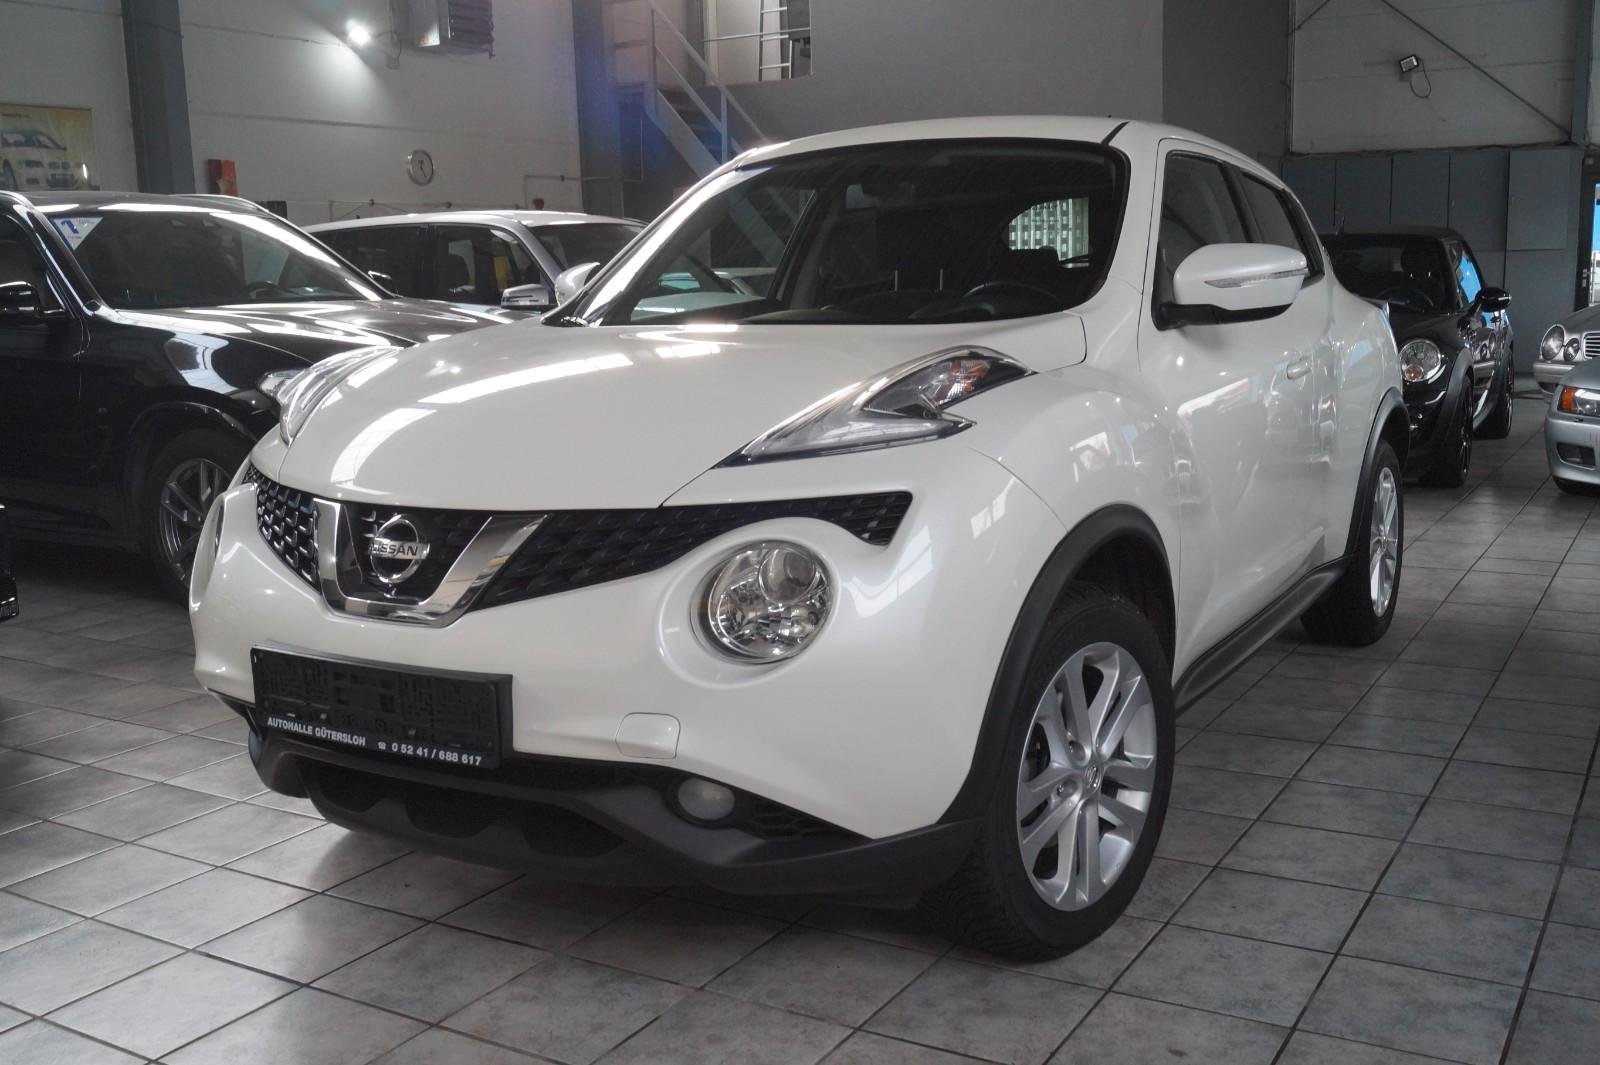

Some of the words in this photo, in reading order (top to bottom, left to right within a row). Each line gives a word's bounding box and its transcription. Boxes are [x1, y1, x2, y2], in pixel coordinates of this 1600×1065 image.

[267, 717, 312, 735] AUTOHALLE
[315, 726, 366, 746] GÜTERSLOH
[392, 743, 398, 752] 0
[401, 744, 413, 755] 52
[417, 747, 428, 758] 41
[431, 749, 436, 759] /
[439, 750, 458, 762] 688
[461, 754, 482, 766] 617
